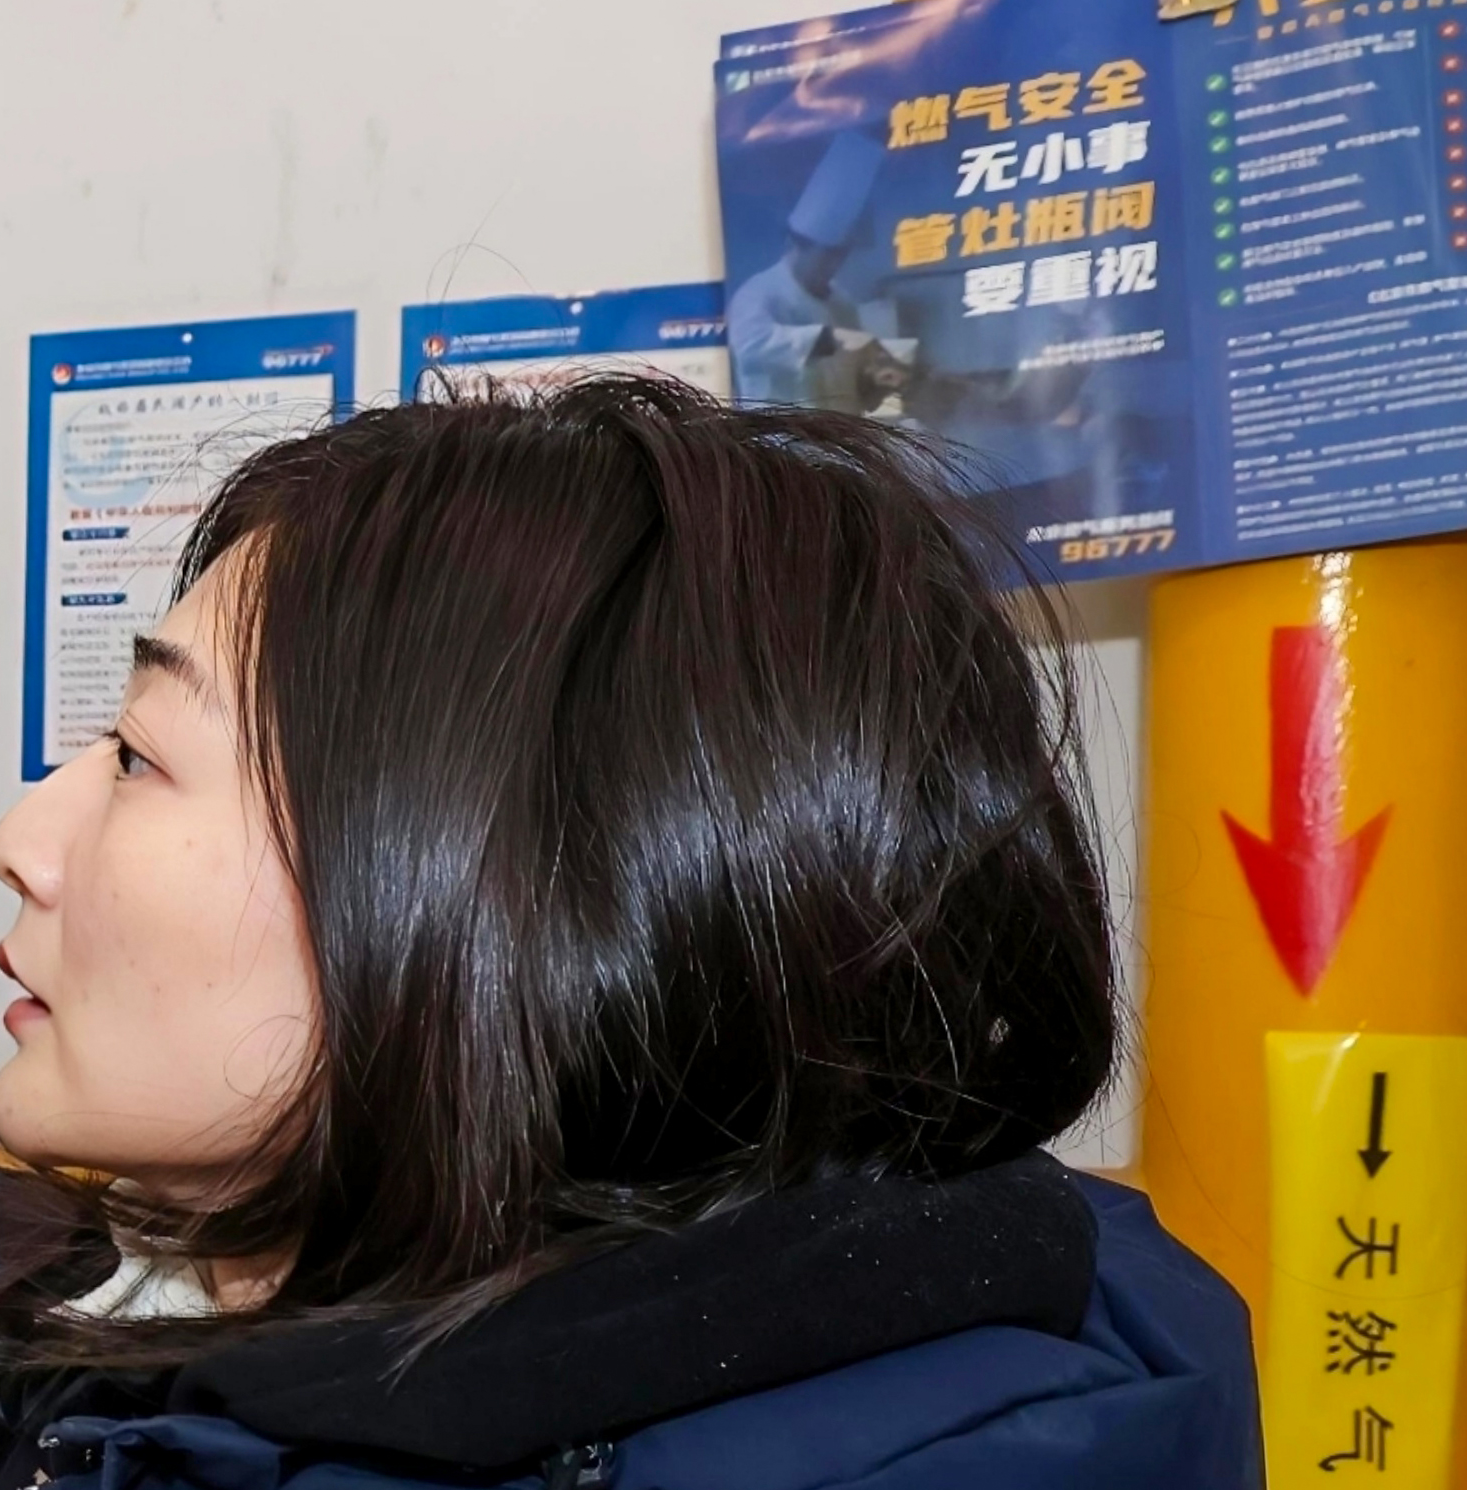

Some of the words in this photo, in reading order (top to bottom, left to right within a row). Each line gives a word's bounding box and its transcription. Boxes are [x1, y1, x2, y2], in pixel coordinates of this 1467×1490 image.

[887, 59, 1146, 150] 燃气安全
[954, 120, 1150, 198] 无小事
[894, 181, 1156, 269] 管灶瓶阀
[963, 241, 1159, 317] 要重视
[1060, 528, 1176, 563] 96777
[1318, 1215, 1400, 1472] 天然气
